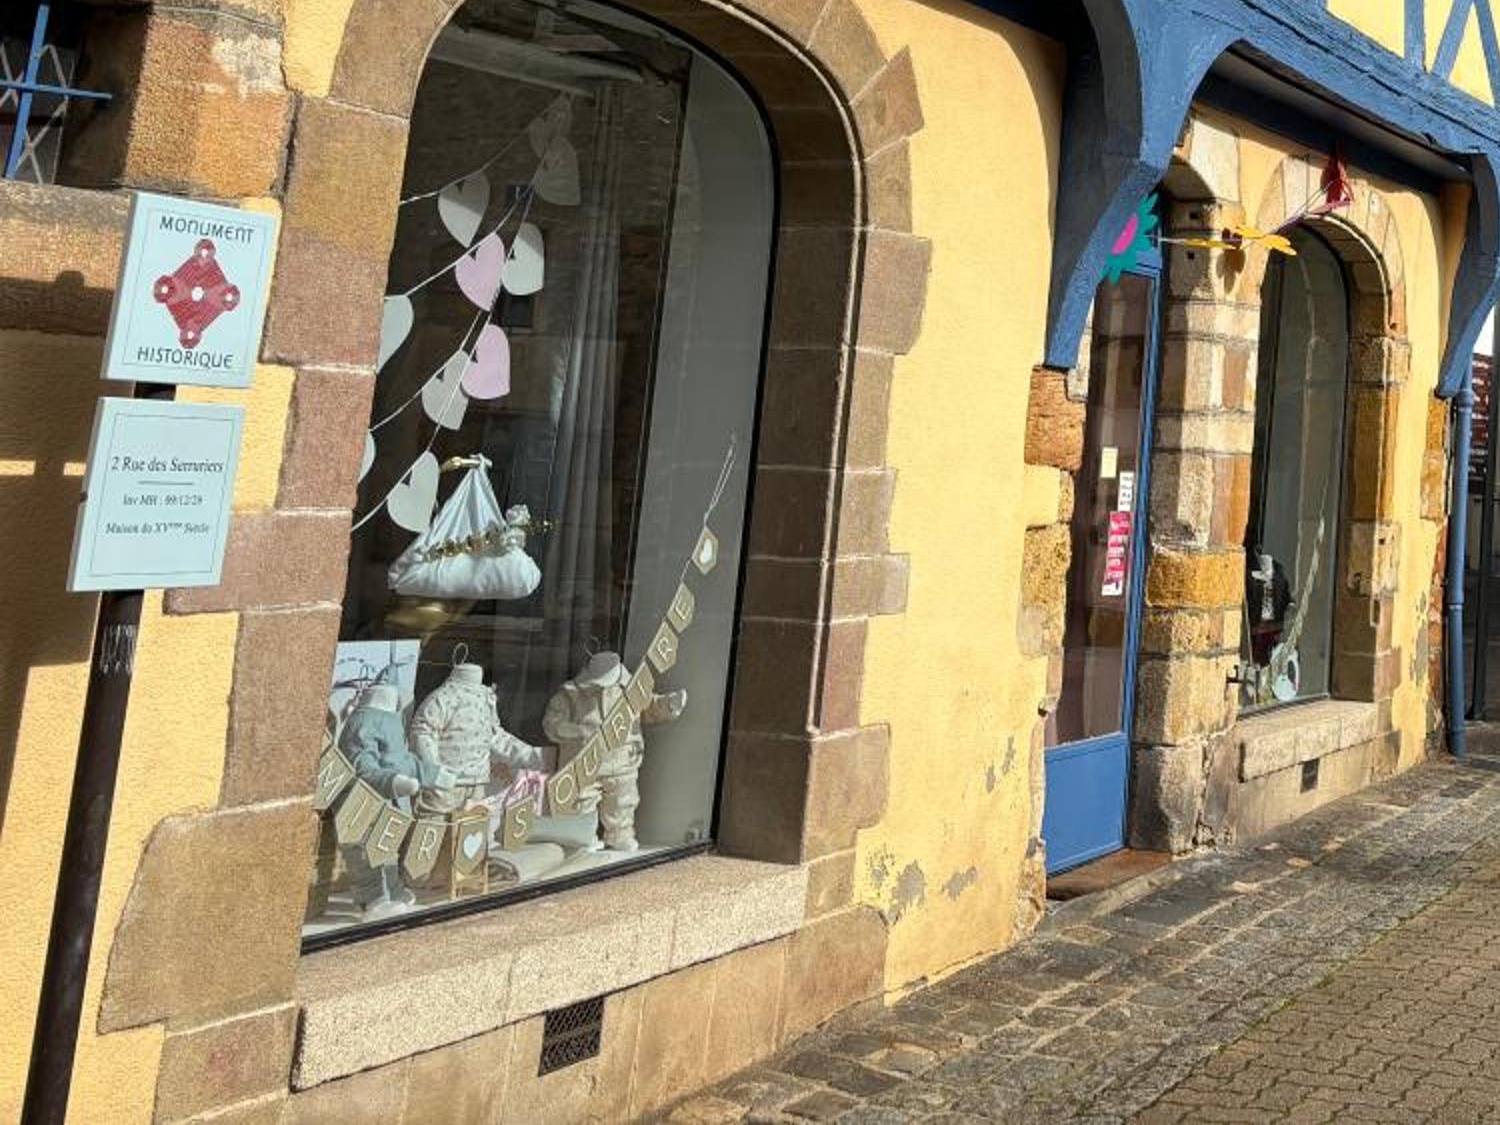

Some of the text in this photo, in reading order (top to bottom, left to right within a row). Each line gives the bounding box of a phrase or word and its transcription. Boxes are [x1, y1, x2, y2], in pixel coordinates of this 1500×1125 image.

[159, 215, 254, 244] MONUMENT
[137, 346, 235, 370] HISTORIQUE
[111, 456, 225, 473] 2 Rue des Serruriers
[140, 494, 159, 506] MH
[105, 522, 138, 534] Maison
[317, 595, 691, 861] MIER SOURIRE
